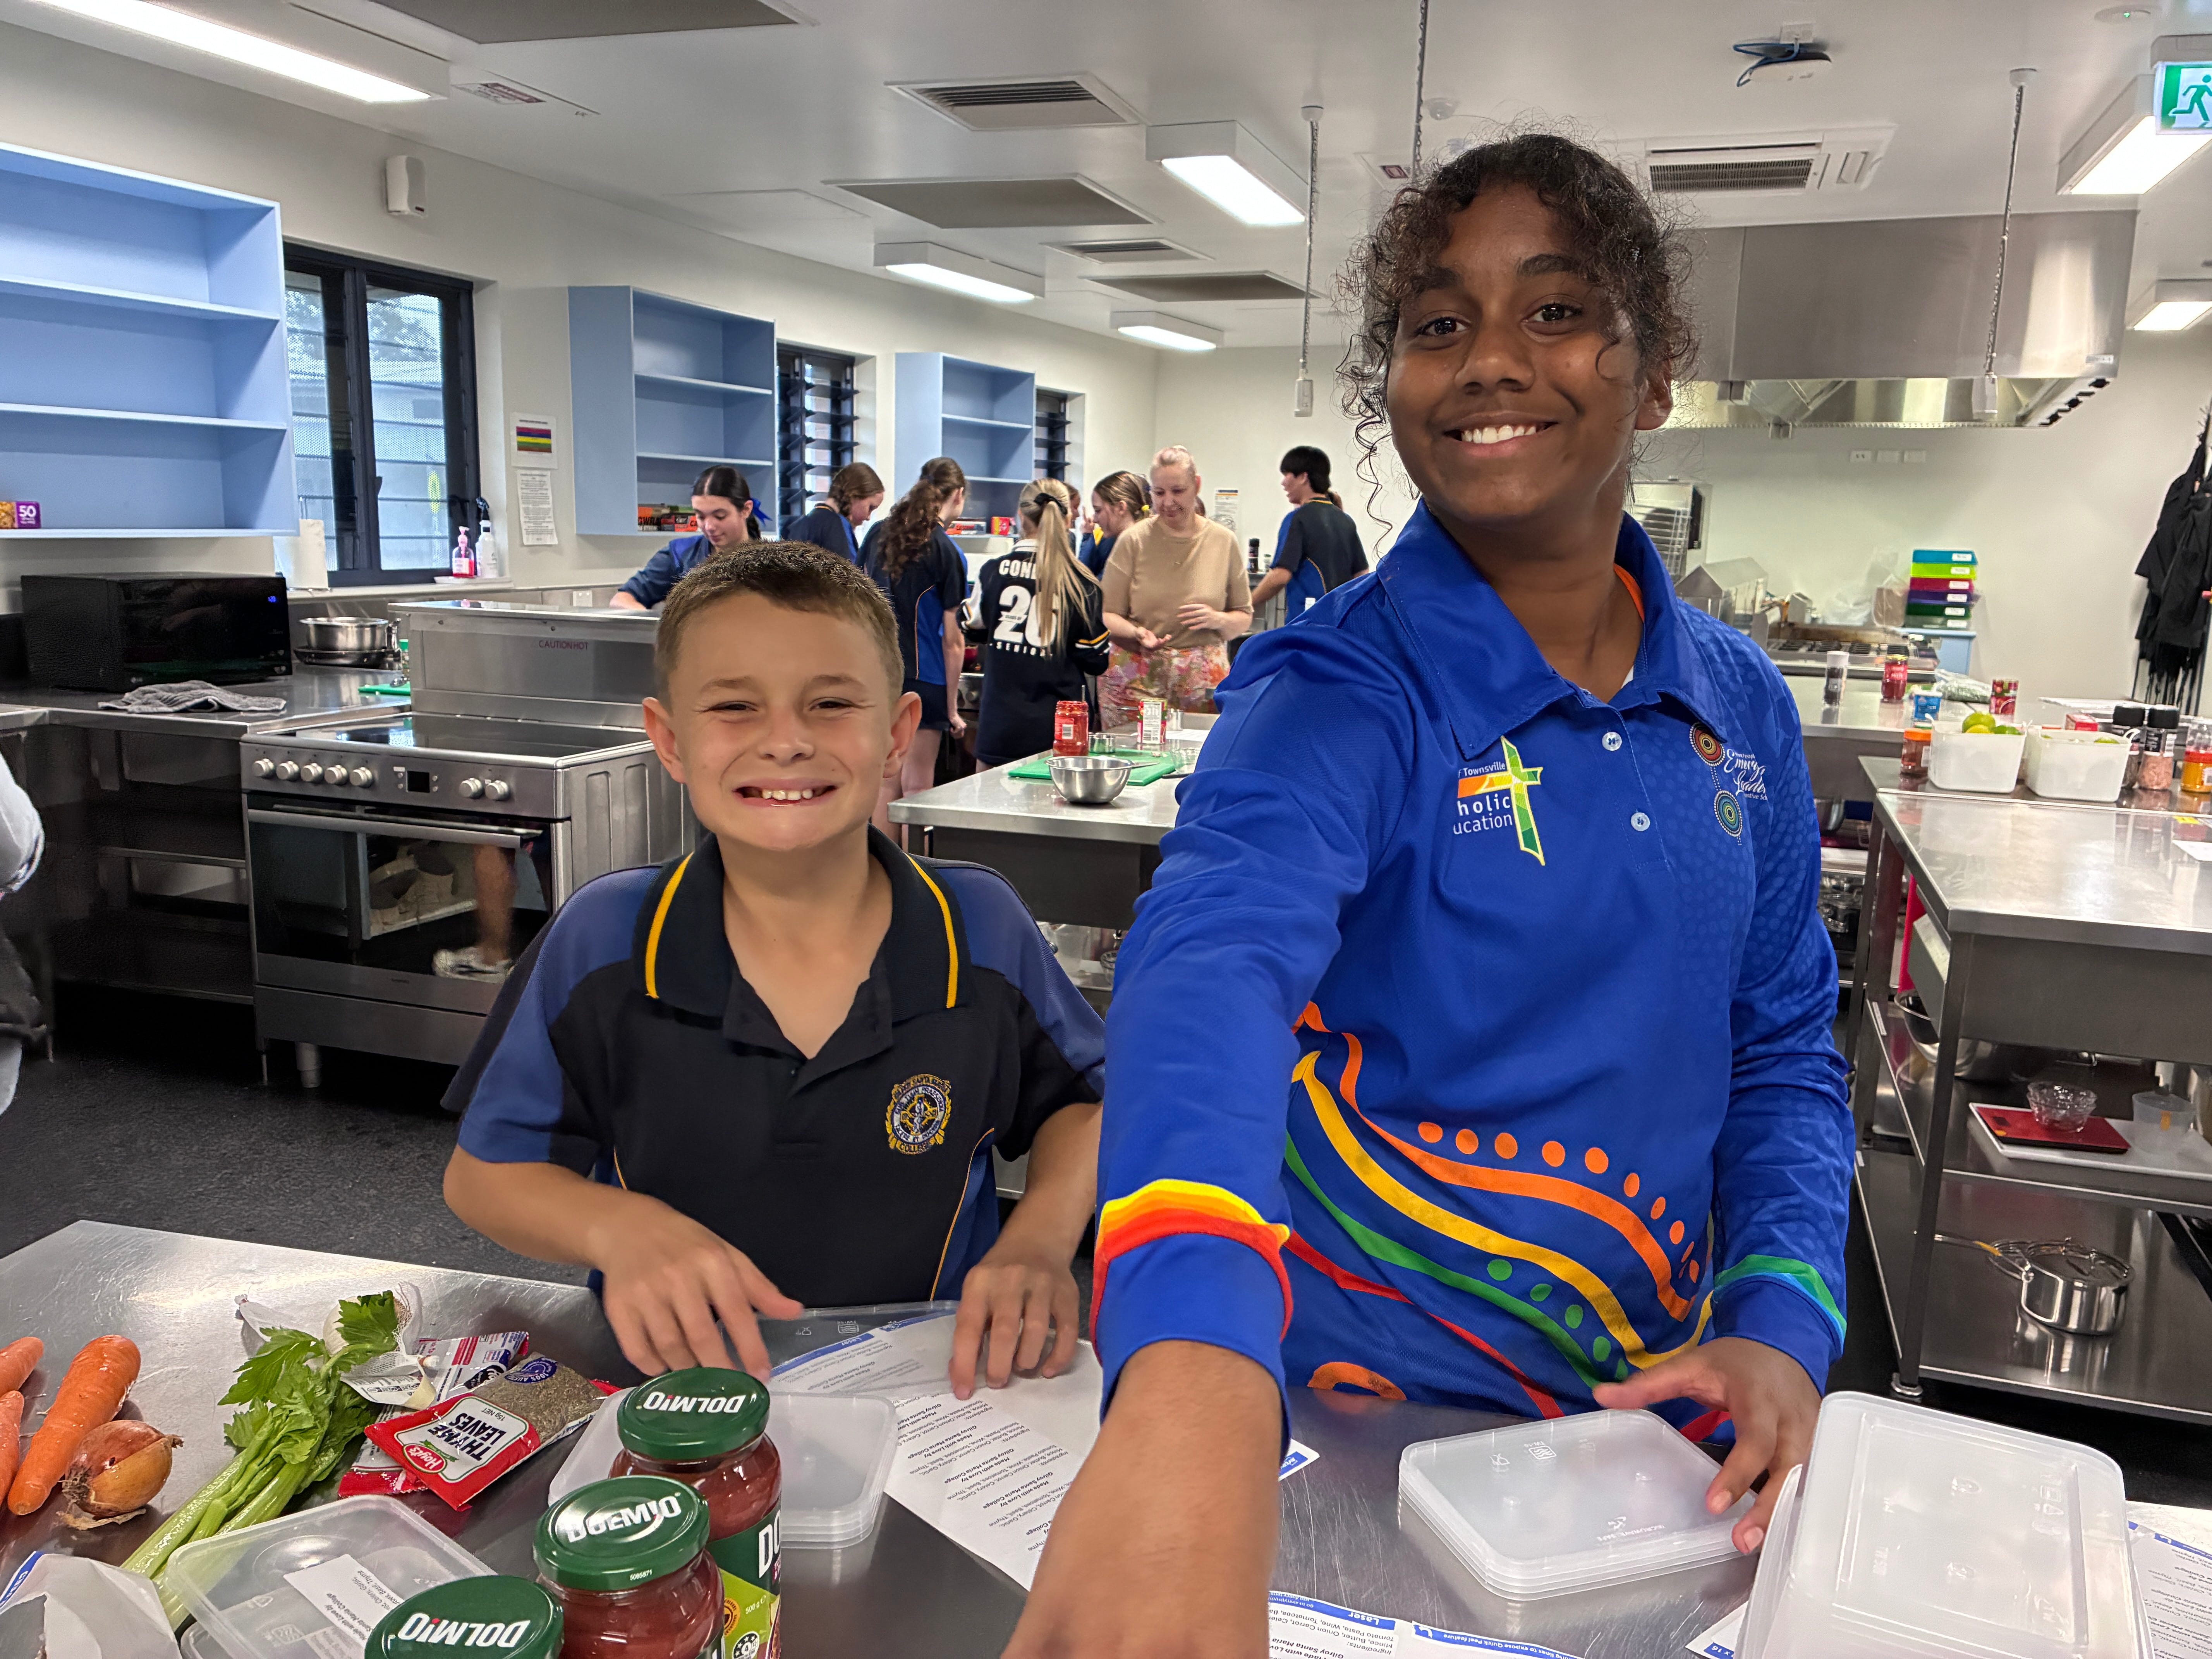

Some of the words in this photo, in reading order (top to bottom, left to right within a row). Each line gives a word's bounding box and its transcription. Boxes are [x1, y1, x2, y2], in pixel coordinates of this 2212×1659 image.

[19, 505, 36, 517] 50
[539, 640, 572, 649] CAUTION
[573, 641, 589, 650] HOT
[1464, 761, 1506, 776] Townsville
[530, 1372, 548, 1381] 100%
[481, 1407, 495, 1415] NET
[495, 1411, 505, 1421] 15g
[448, 1413, 507, 1445] LEAVES
[407, 1446, 442, 1470] Hoyt's
[745, 1604, 755, 1614] 500
[1347, 1611, 1380, 1625] Laser
[1289, 1620, 1316, 1632] Carrot,
[1319, 1619, 1341, 1630] Wine,
[1342, 1625, 1365, 1635] Paste,
[1316, 1626, 1340, 1637] Onion
[1366, 1630, 1394, 1642] Tomato
[1443, 1632, 1468, 1642] feature
[1271, 1637, 1294, 1648] Maria
[1341, 1632, 1366, 1643] Butter,
[1468, 1637, 1483, 1645] Peel
[1295, 1643, 1319, 1654] Santa
[1346, 1640, 1392, 1656] Ingredients:
[1367, 1638, 1393, 1649] Mince,
[1483, 1639, 1503, 1649] Quick
[1285, 1647, 1302, 1656] with
[1319, 1648, 1344, 1659] Gilroy
